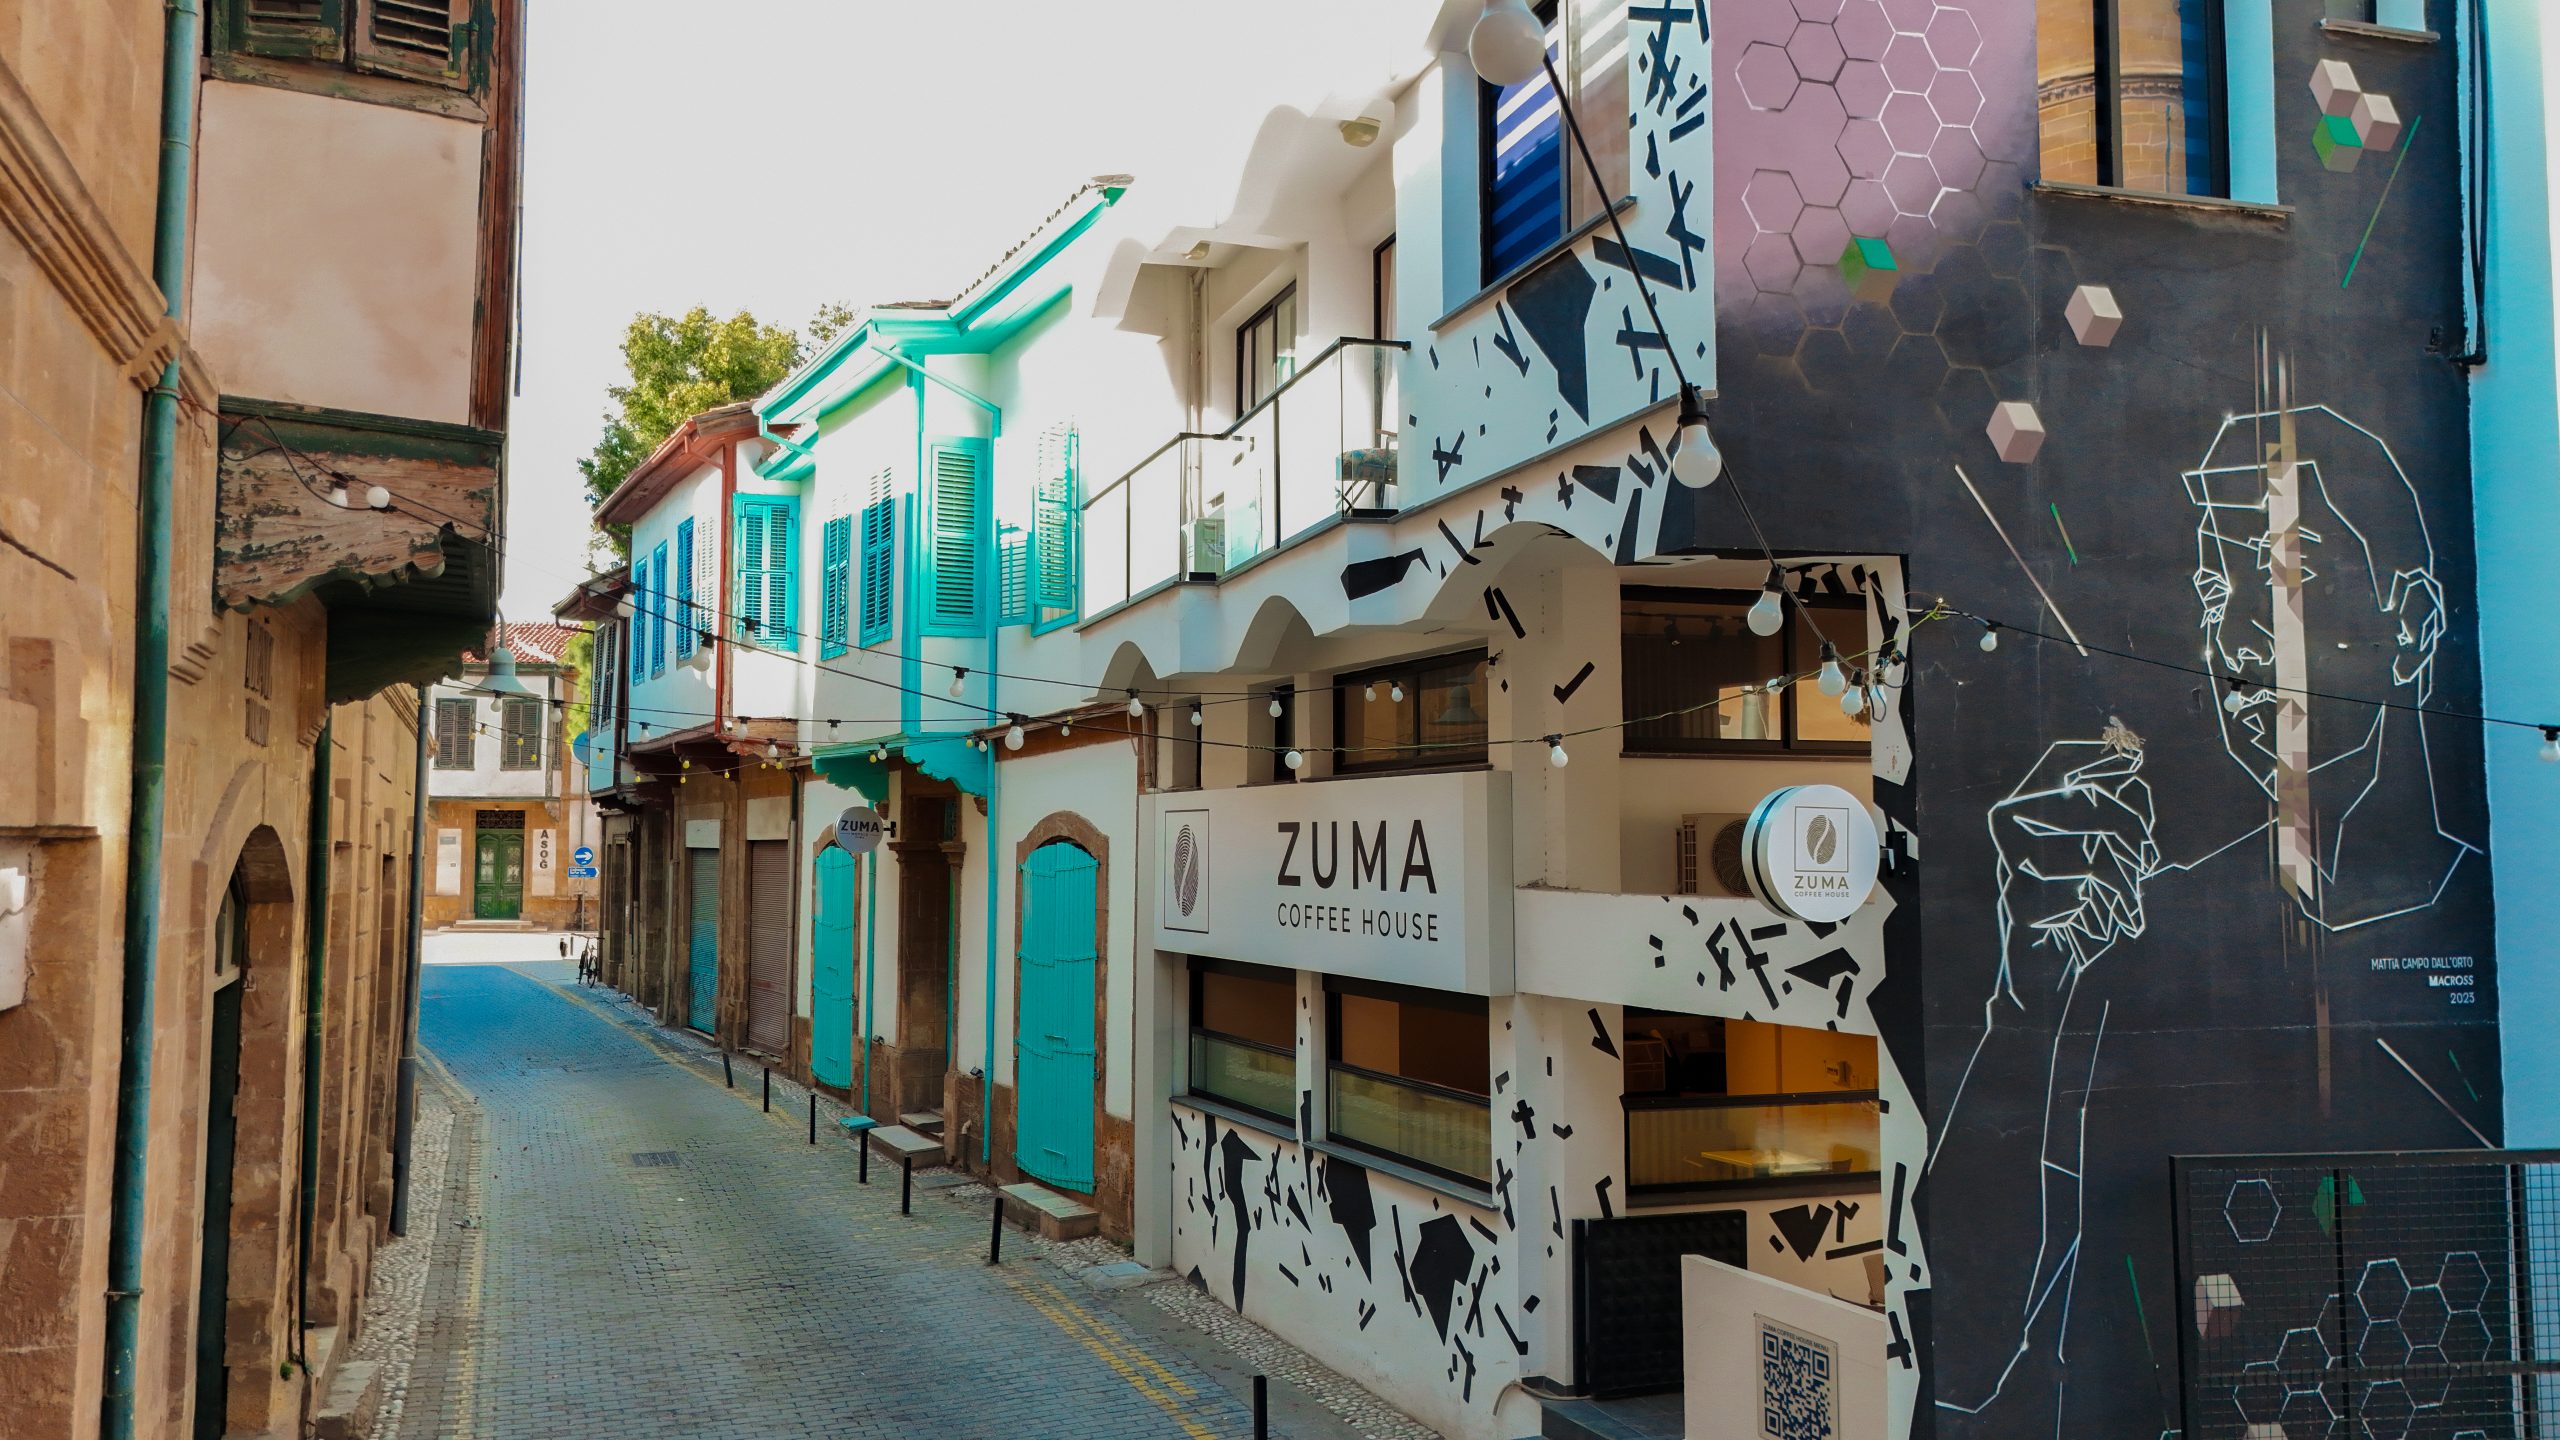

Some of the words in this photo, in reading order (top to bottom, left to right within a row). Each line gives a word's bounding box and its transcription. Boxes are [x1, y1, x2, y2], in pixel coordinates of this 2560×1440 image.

[841, 820, 879, 832] ZUMA
[1278, 819, 1437, 894] ZUMA
[1794, 876, 1849, 890] ZUMA
[1278, 902, 1351, 933] COFFEE
[1362, 908, 1439, 942] HOUSE
[2401, 957, 2430, 969] CAMPO
[2431, 956, 2474, 969] DALL'ORTO
[2428, 975, 2474, 987] MACROSS
[2450, 992, 2475, 1004] 2023
[1762, 1323, 1776, 1332] ZUMA
[1777, 1328, 1796, 1340] COFFEE
[1796, 1335, 1813, 1346] HOUSE
[1813, 1341, 1829, 1352] MENU
